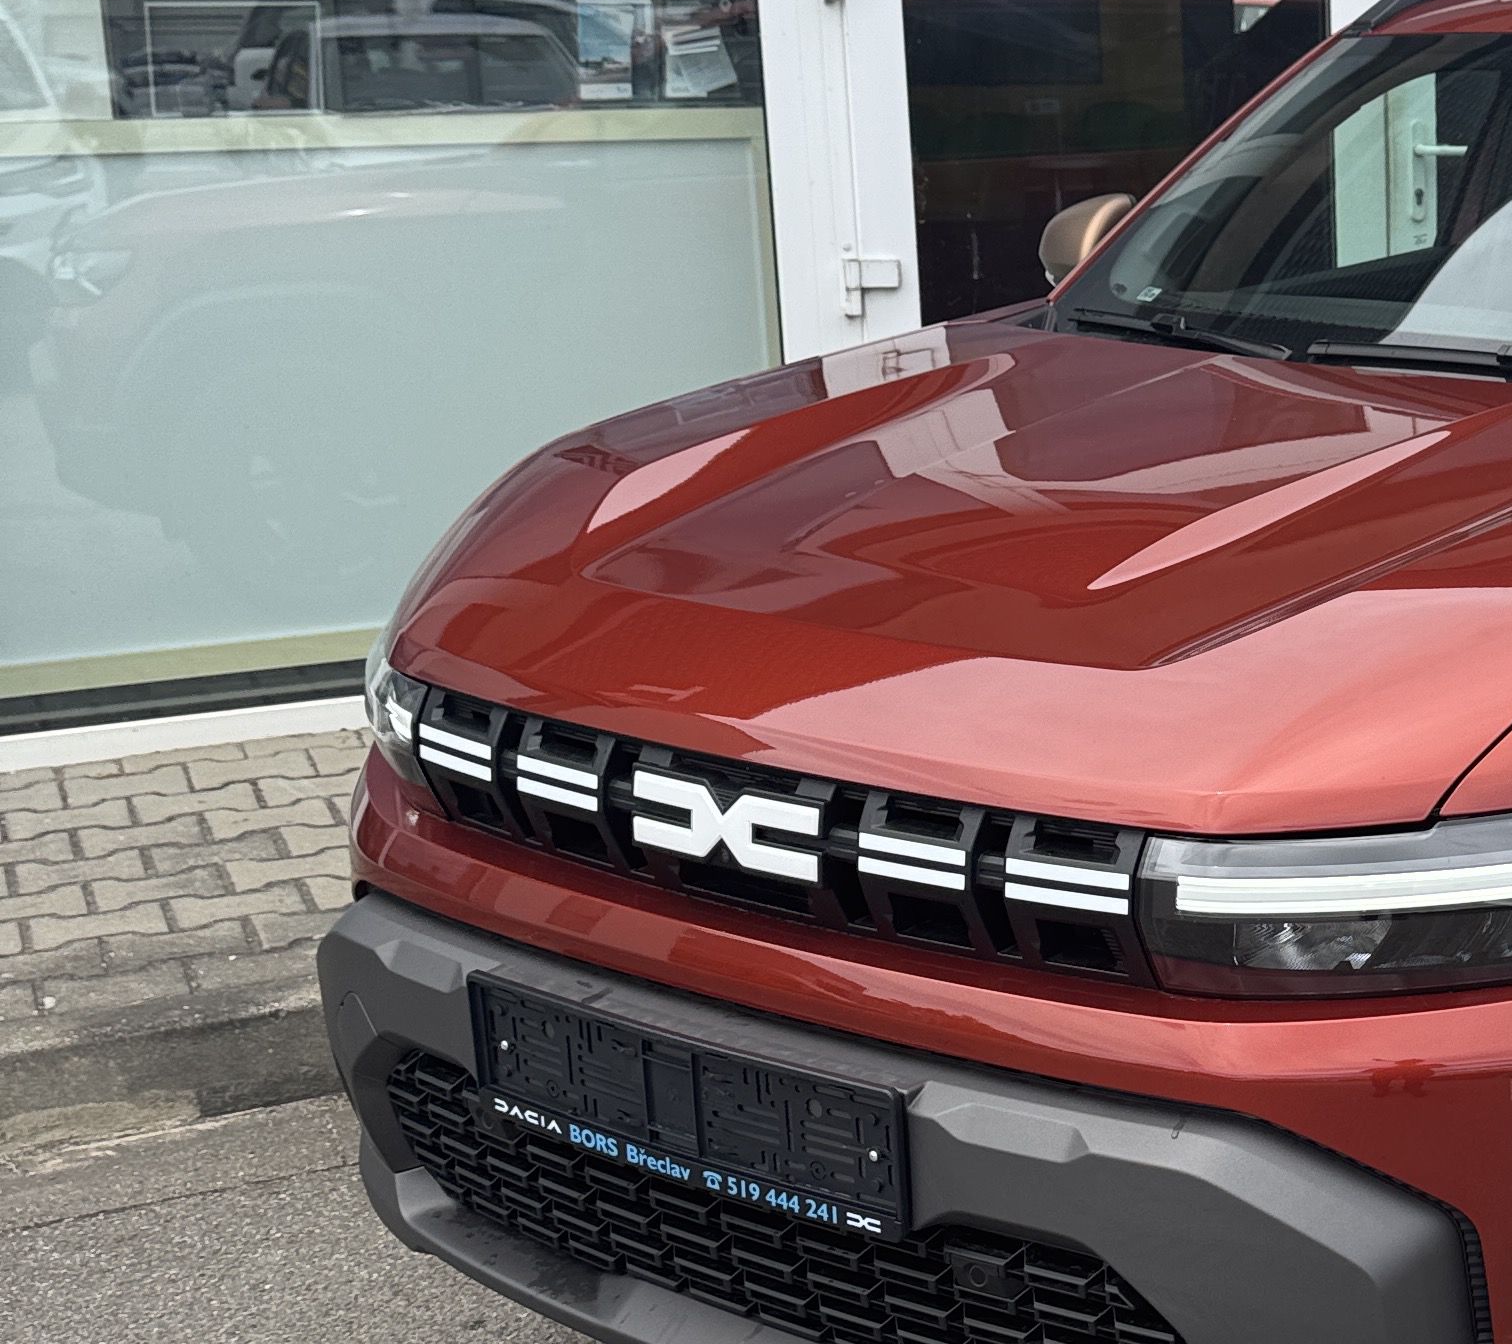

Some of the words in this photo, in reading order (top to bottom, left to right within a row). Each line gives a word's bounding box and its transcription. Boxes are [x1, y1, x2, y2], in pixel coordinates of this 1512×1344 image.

[493, 1097, 563, 1134] DACIA
[568, 1123, 619, 1157] BORS
[626, 1143, 691, 1181] Břeclav
[727, 1176, 761, 1201] 519
[765, 1188, 800, 1214] 444
[805, 1199, 838, 1224] 241
